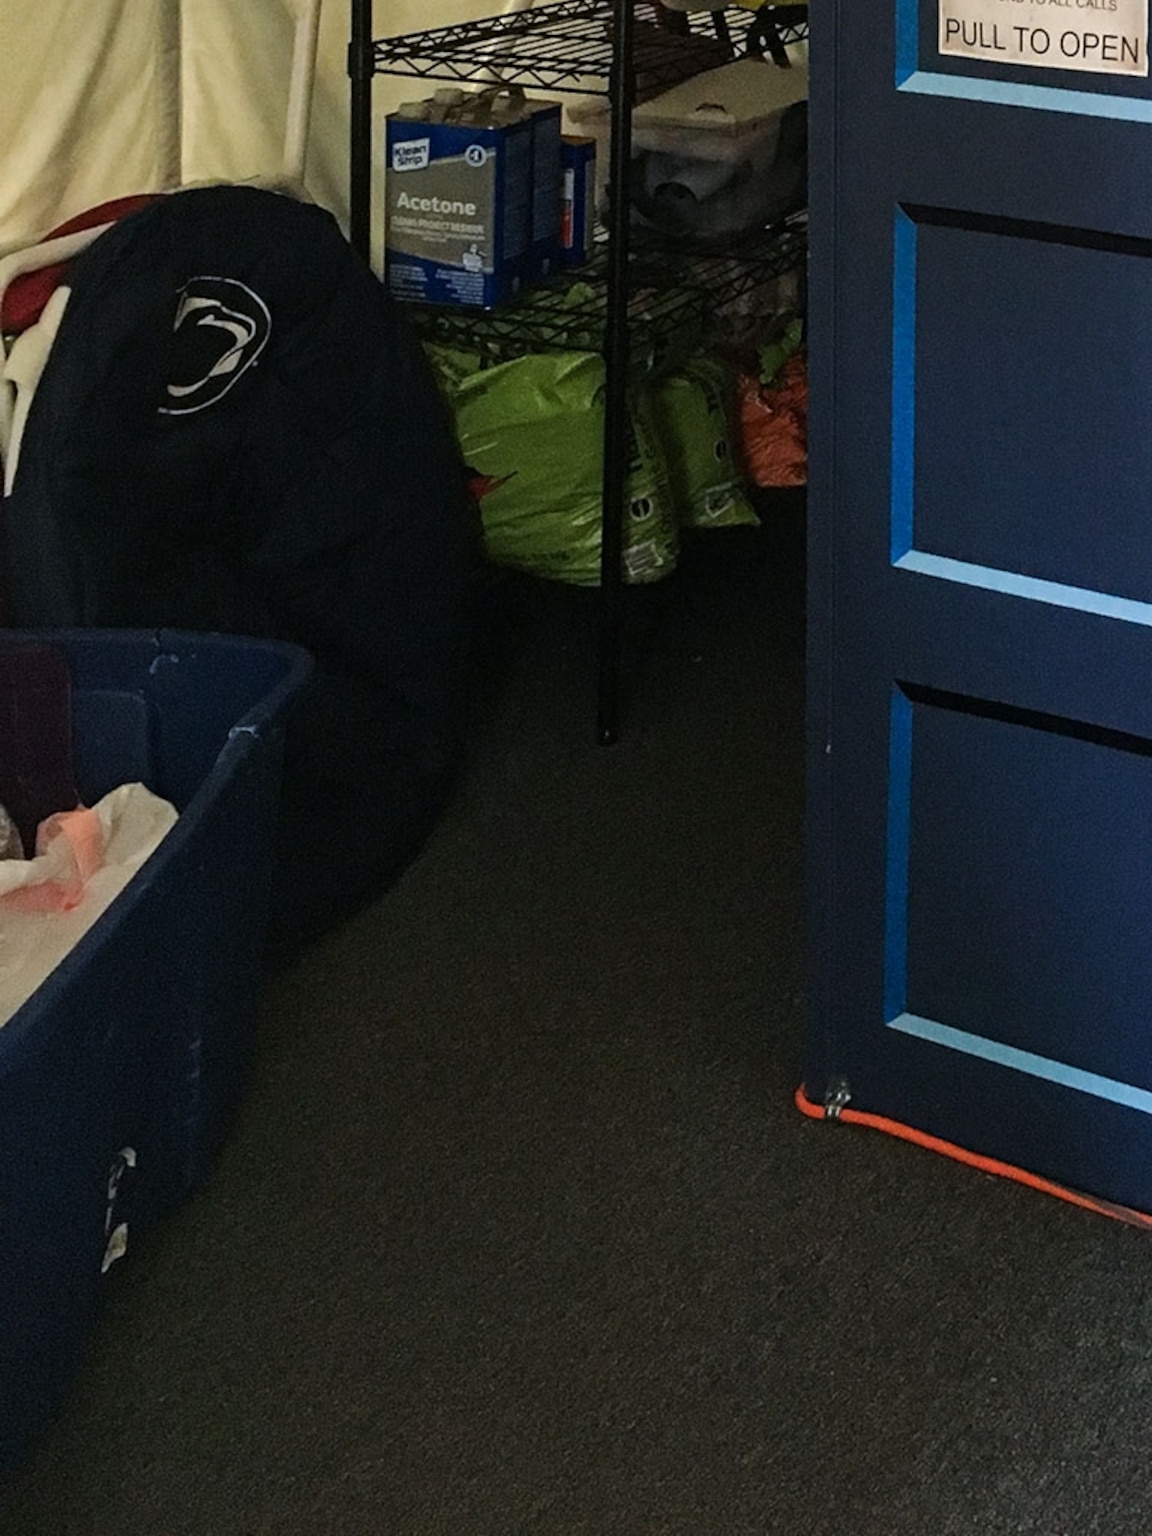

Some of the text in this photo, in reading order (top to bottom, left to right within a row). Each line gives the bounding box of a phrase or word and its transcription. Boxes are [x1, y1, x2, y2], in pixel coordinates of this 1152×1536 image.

[945, 18, 1139, 64] PULL TO OPEN
[396, 192, 477, 216] Acetone
